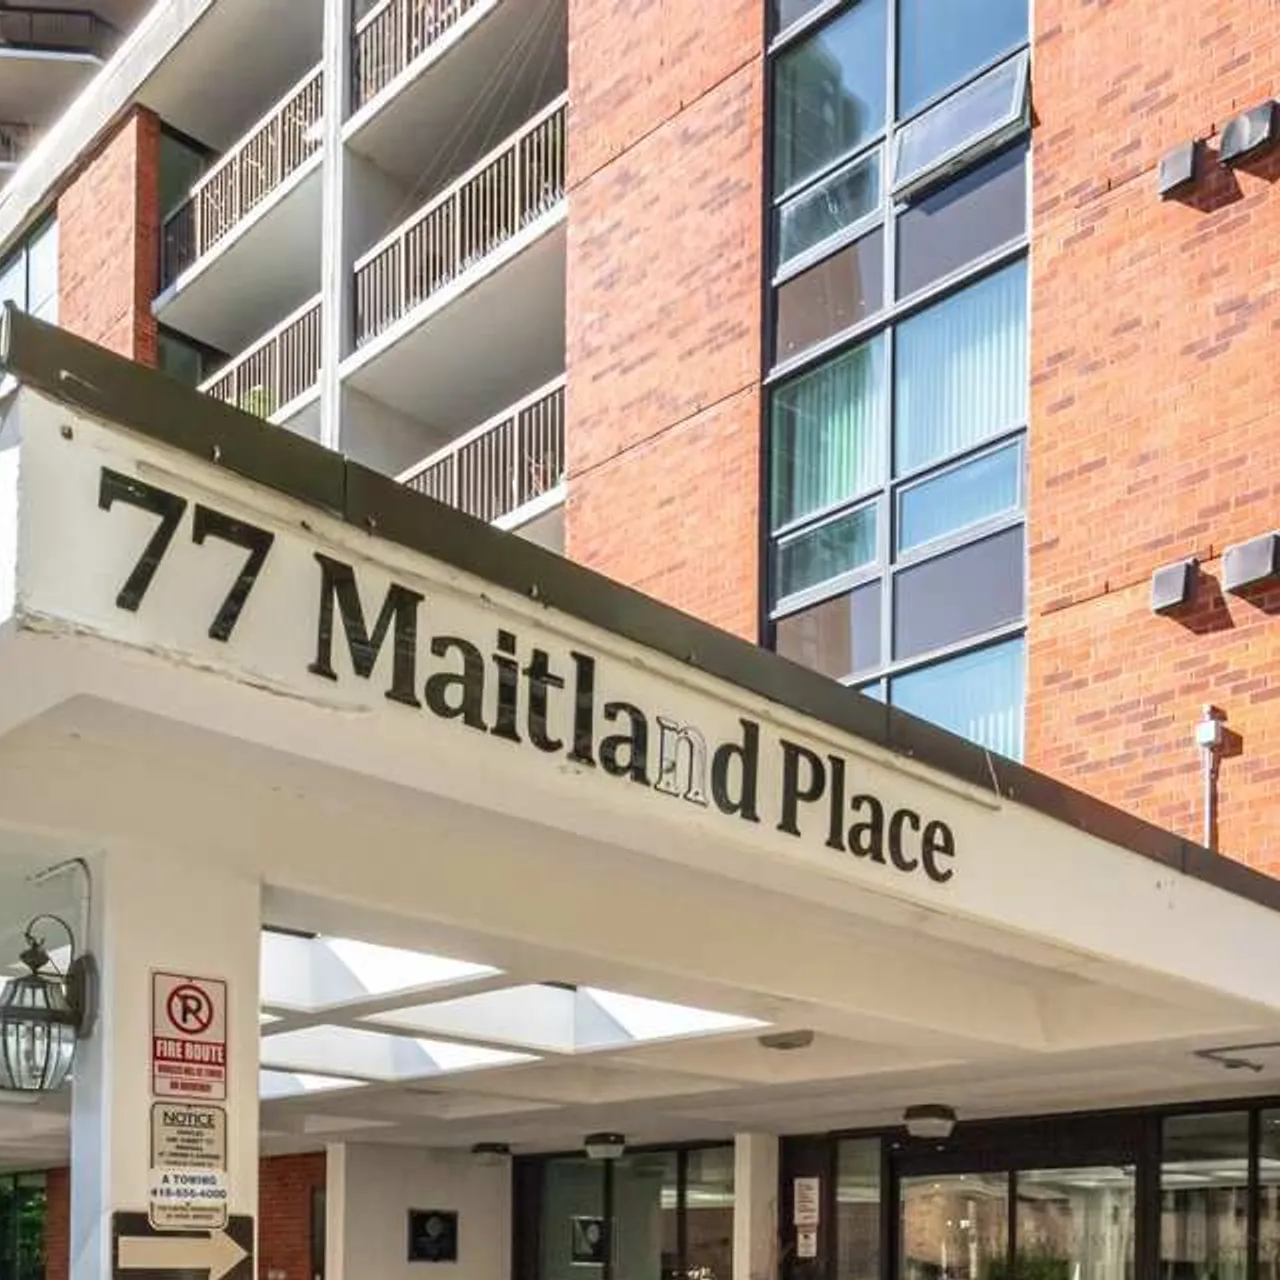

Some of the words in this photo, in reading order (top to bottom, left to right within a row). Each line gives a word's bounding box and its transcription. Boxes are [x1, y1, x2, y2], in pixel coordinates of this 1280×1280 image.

[98, 466, 275, 642] 77
[308, 552, 760, 823] Maitland
[776, 739, 956, 883] Place
[156, 1040, 183, 1058] FIRE
[184, 1042, 225, 1063] ROUTE
[163, 1111, 215, 1127] NOTICE
